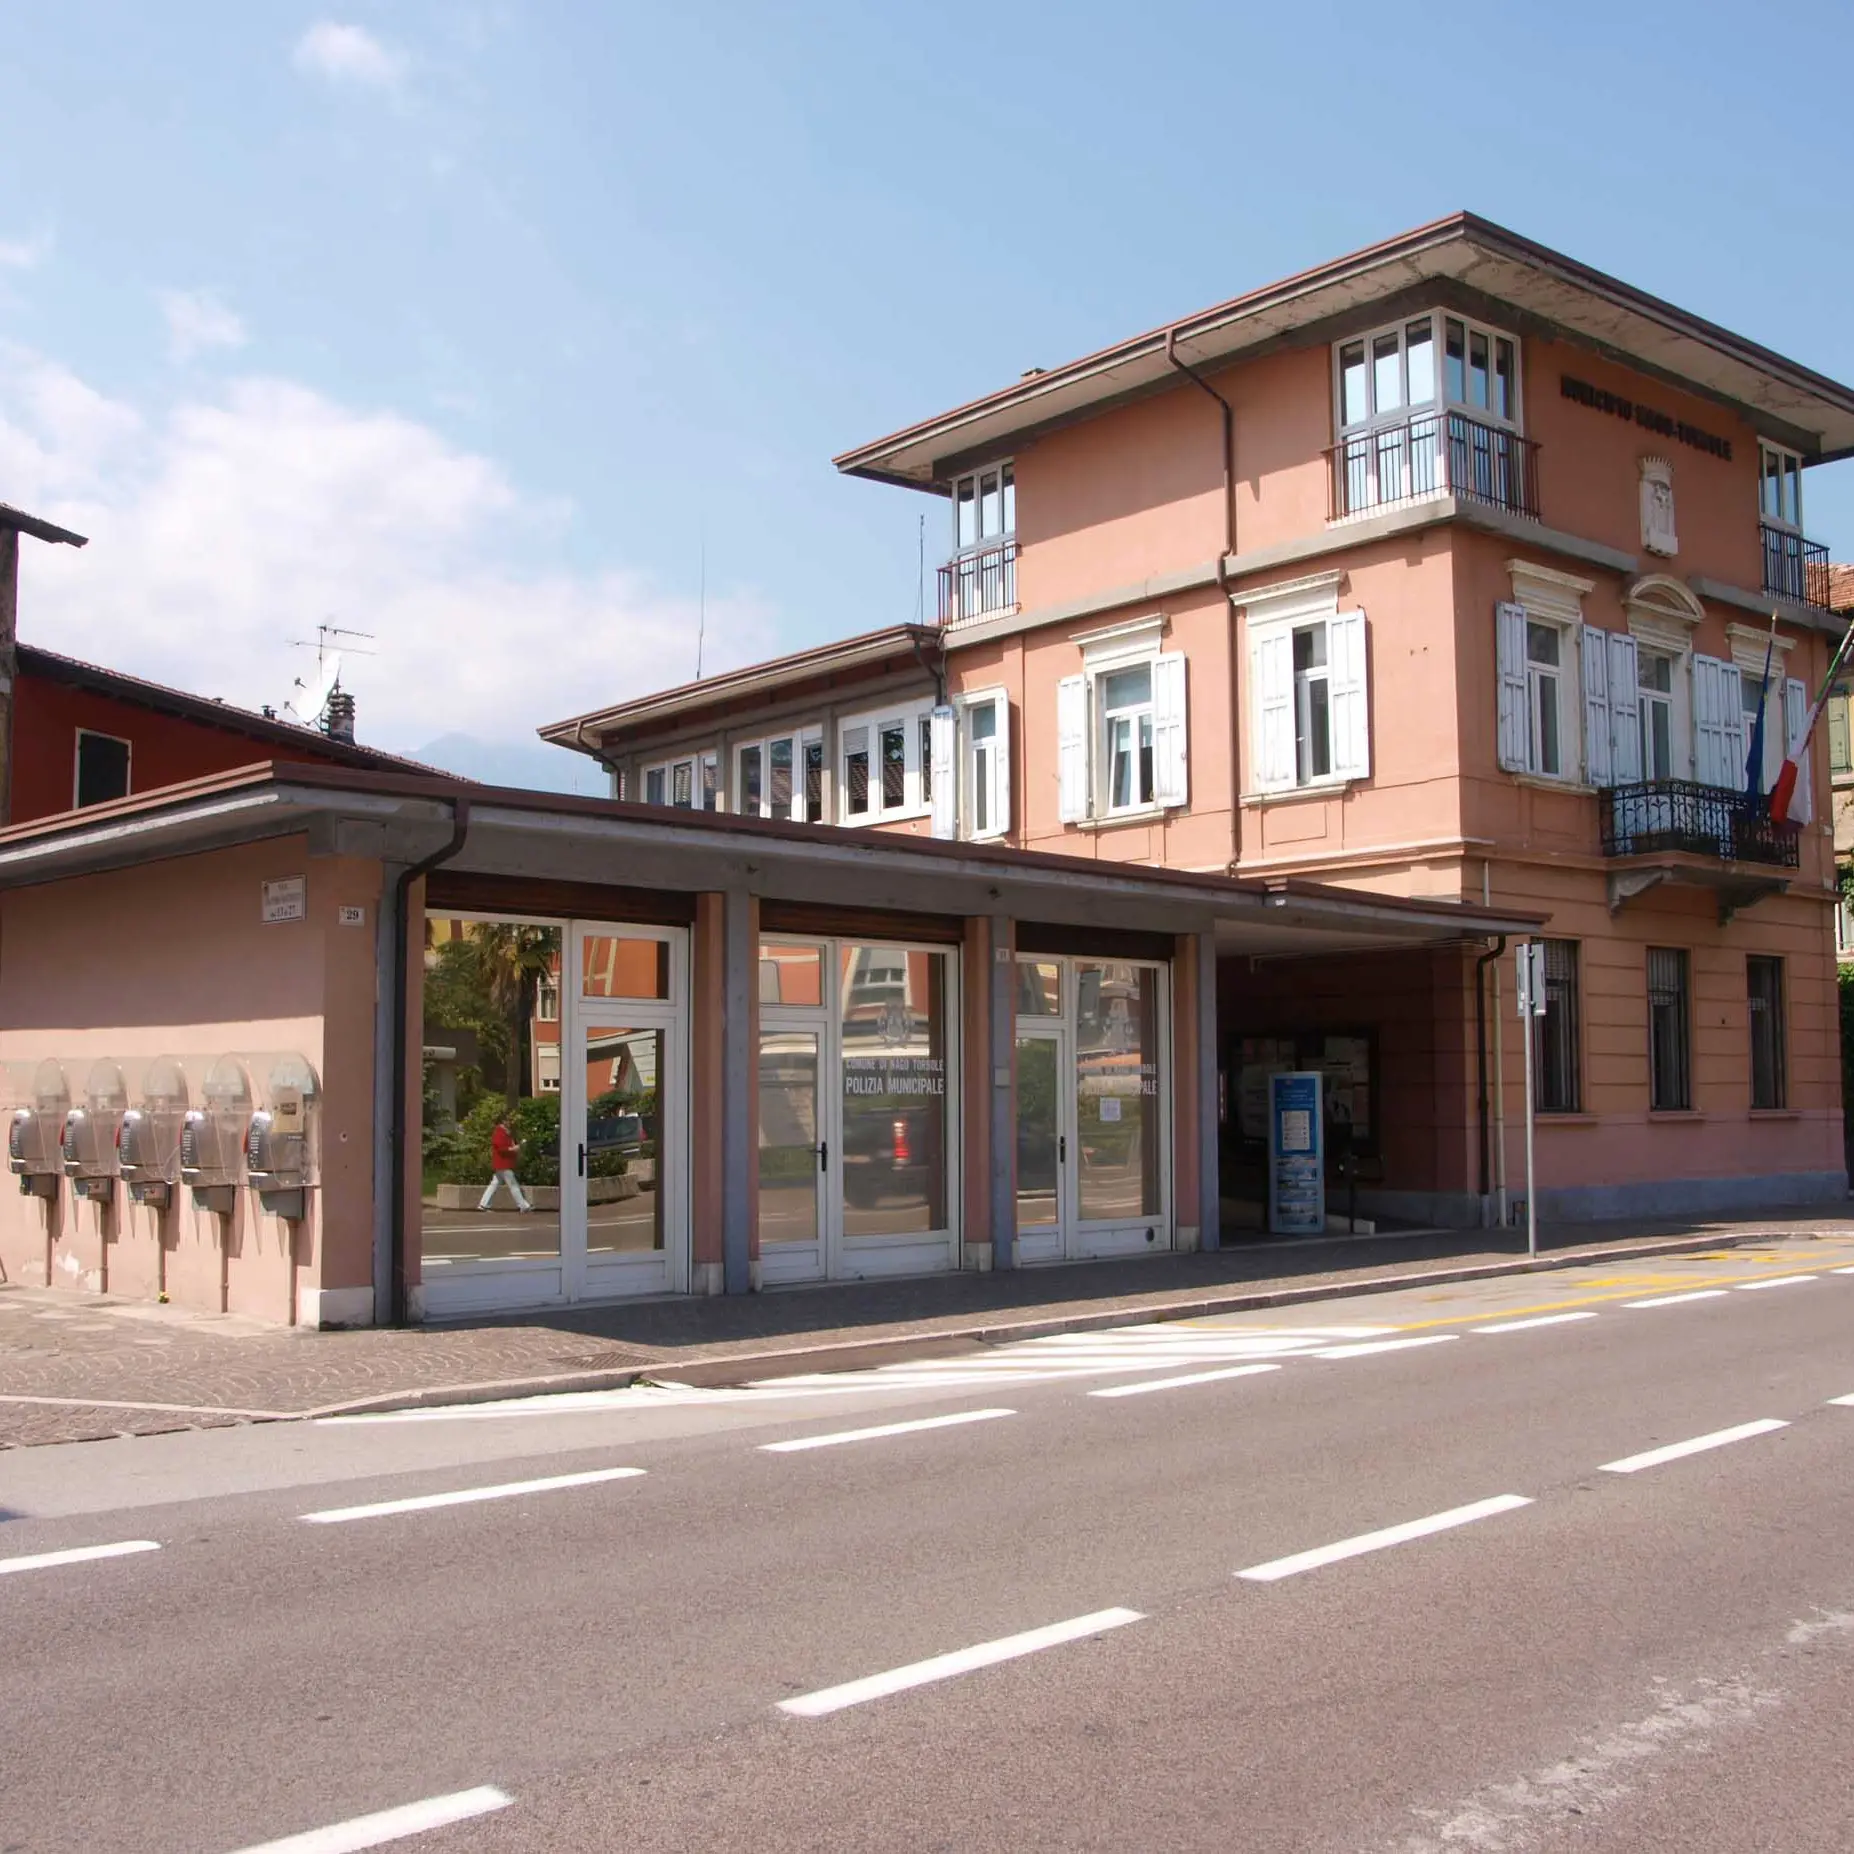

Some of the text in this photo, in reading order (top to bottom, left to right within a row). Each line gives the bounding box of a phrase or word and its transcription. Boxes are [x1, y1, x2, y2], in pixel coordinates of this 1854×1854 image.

[346, 909, 359, 921] 29
[846, 1077, 944, 1095] POLIZIA MUNICIPALE
